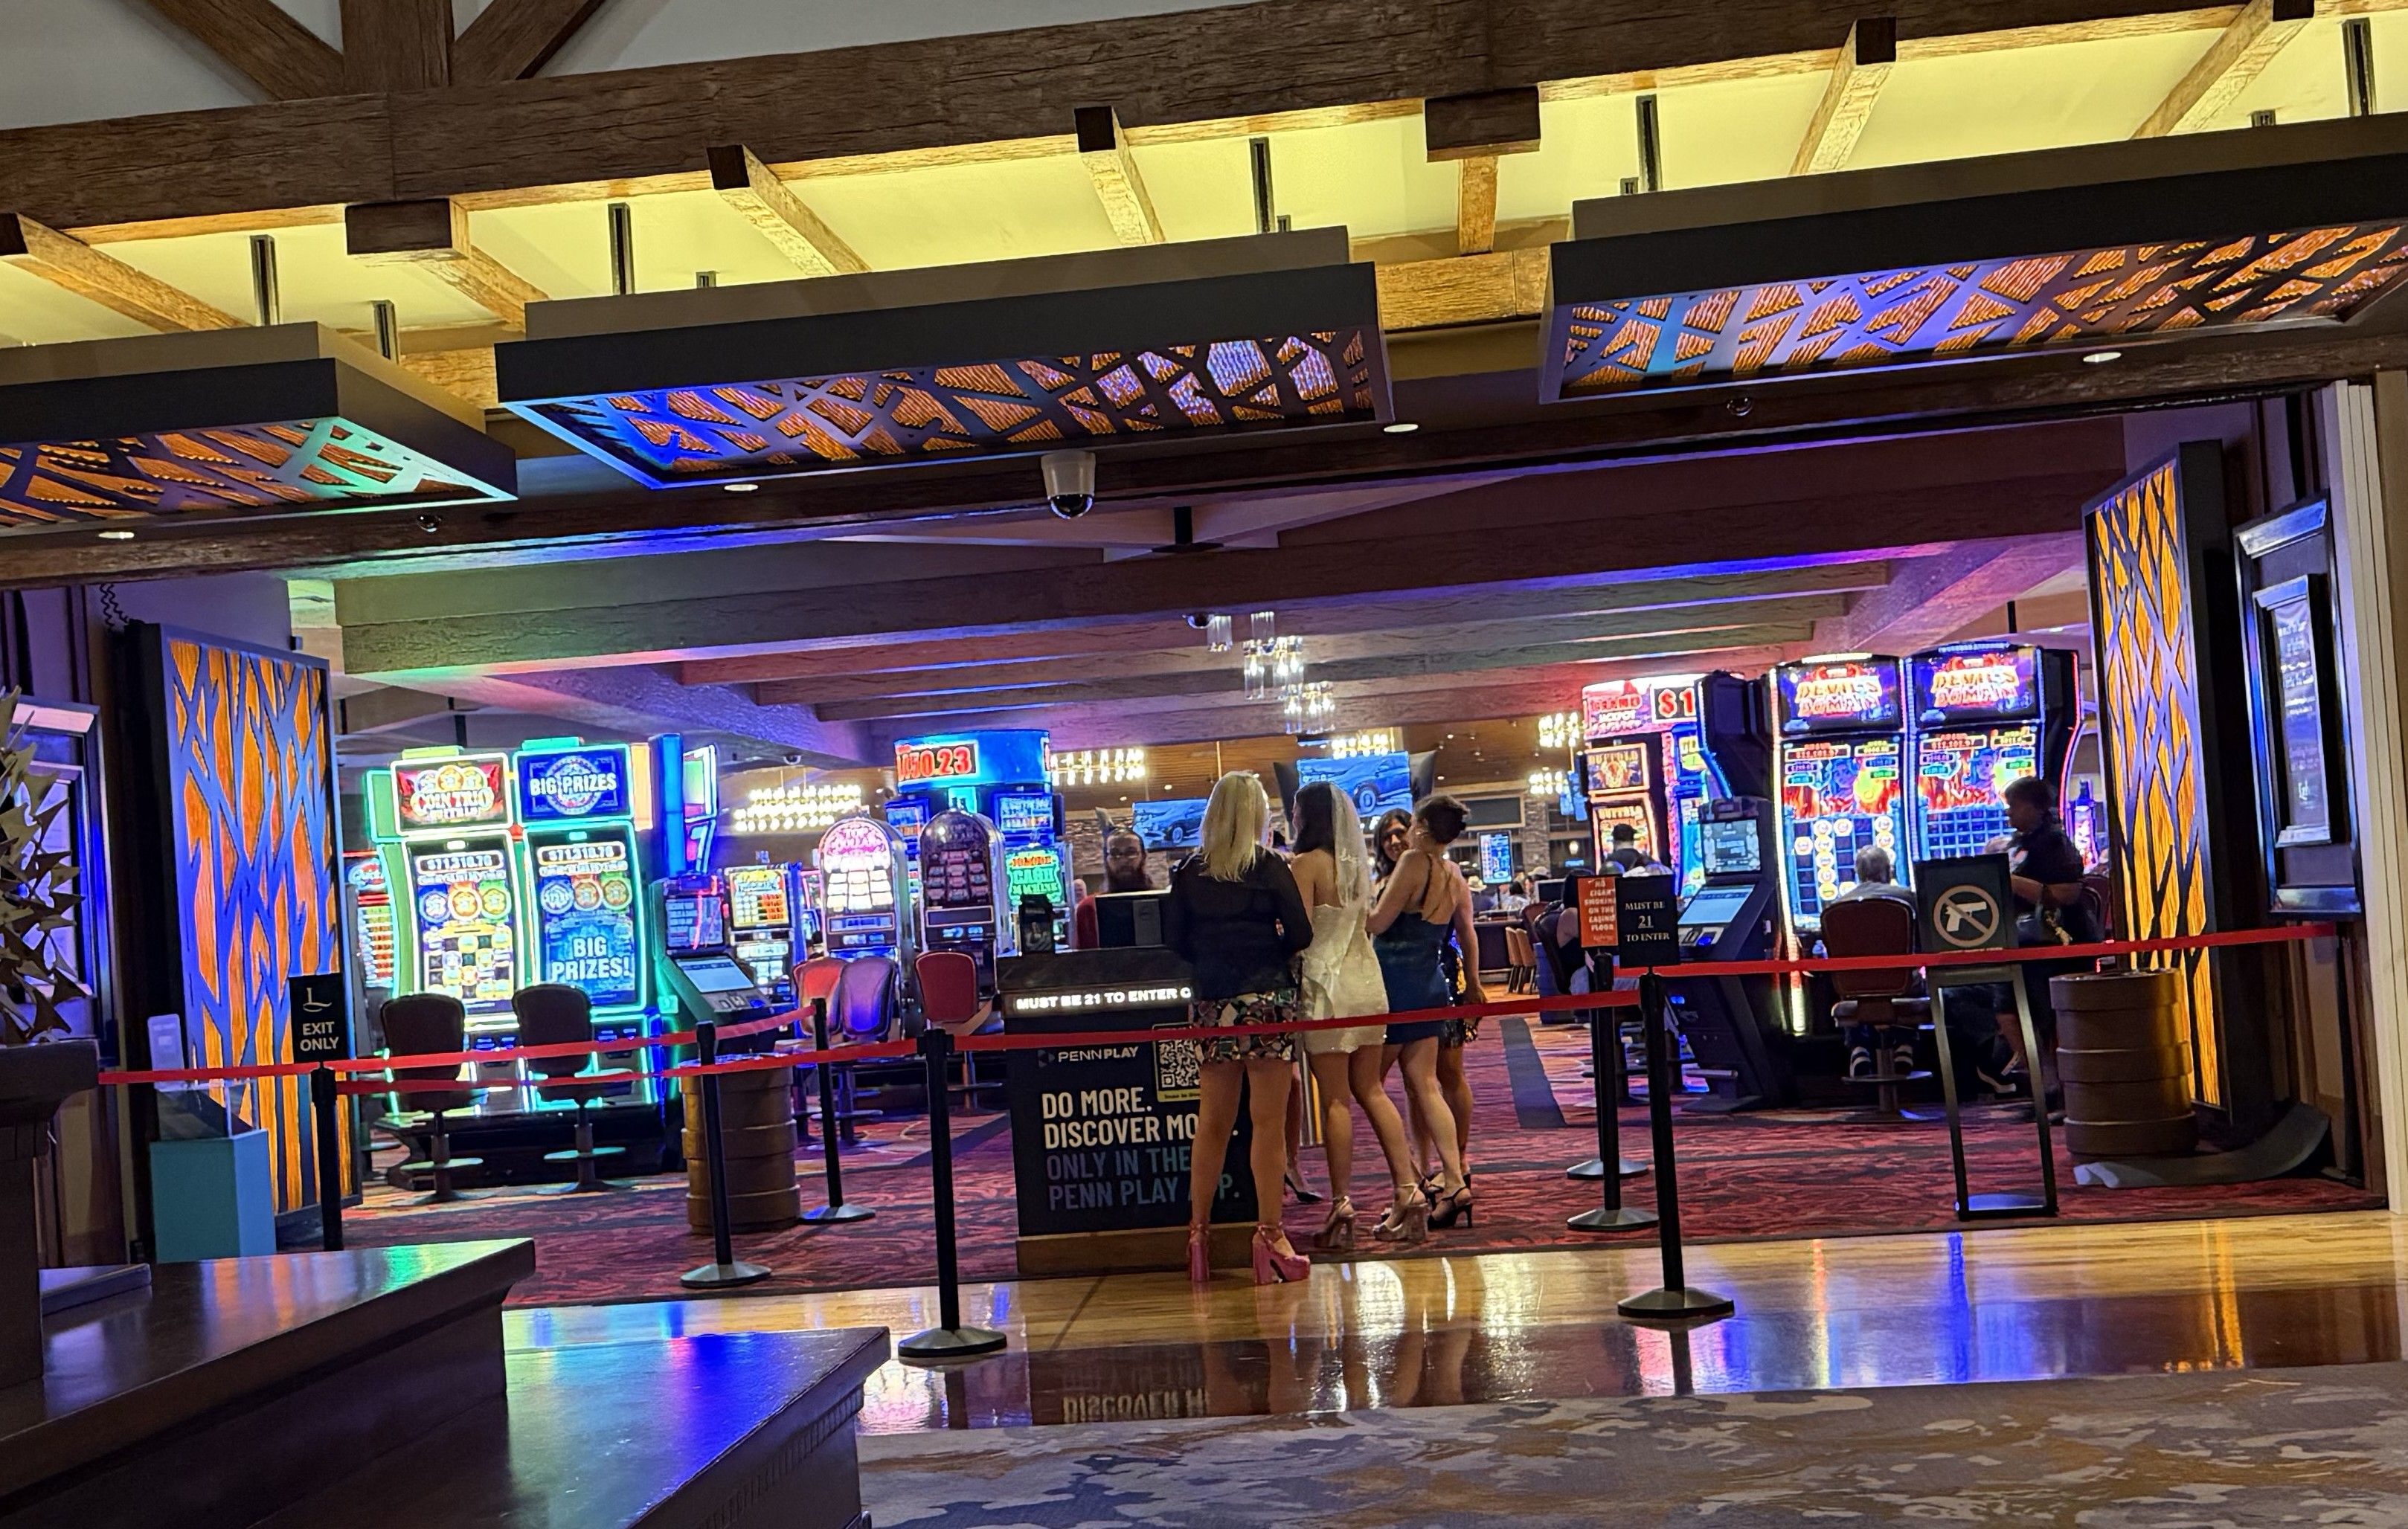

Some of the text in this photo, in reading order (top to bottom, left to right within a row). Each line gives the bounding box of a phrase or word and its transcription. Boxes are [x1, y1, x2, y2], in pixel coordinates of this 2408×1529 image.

[530, 772, 617, 796] BIG PRIZES
[1625, 902, 1651, 910] MUST
[1590, 924, 1614, 932] FLOOR
[1638, 915, 1654, 929] 21
[573, 936, 607, 958] BIG
[1626, 933, 1670, 942] TO ENTER
[551, 956, 631, 982] PRIZES!
[1016, 997, 1058, 1010] MUST
[1061, 994, 1082, 1007] BE
[1084, 993, 1101, 1005] 21
[1104, 991, 1125, 1003] TO
[1128, 988, 1178, 1002] ENTER
[303, 1021, 335, 1035] EXIT
[300, 1037, 339, 1052] ONLY
[1041, 1087, 1152, 1119] DO MORE.
[1044, 1116, 1160, 1149] DISCOVER
[1047, 1146, 1192, 1180] ONLY IN THE
[1049, 1181, 1114, 1211] PENN
[1120, 1176, 1178, 1206] PLAY
